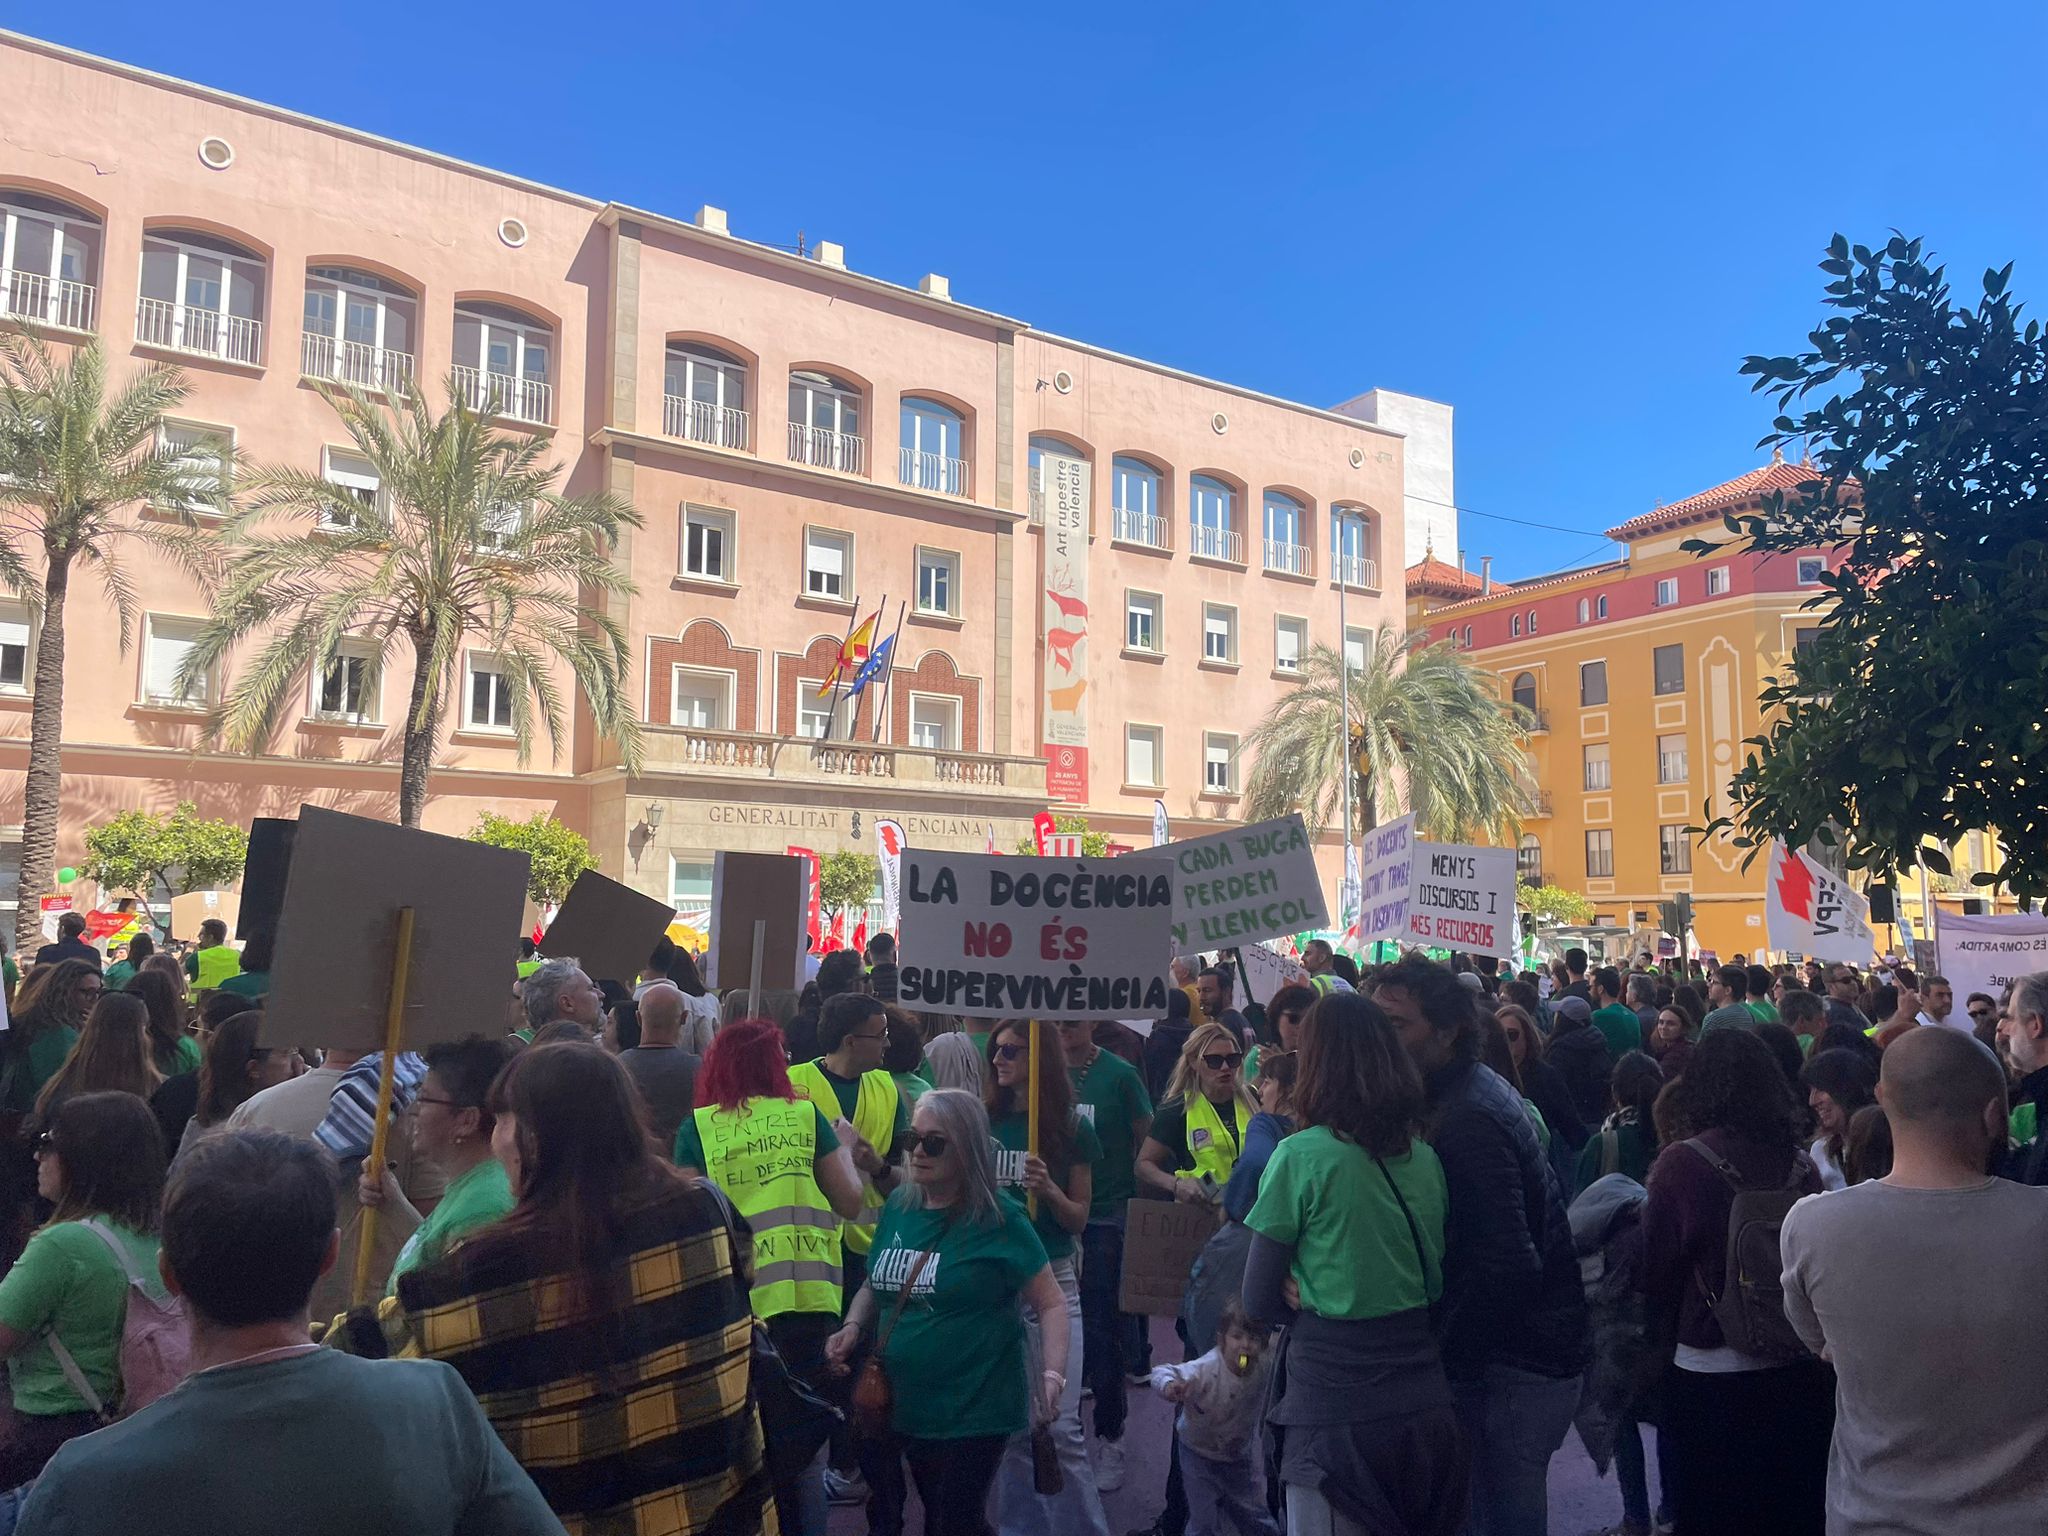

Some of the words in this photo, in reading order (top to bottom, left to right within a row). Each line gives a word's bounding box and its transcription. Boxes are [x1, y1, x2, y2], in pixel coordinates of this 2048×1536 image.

[1057, 460, 1069, 527] rupestre
[1068, 463, 1080, 528] valencià
[1056, 532, 1067, 557] Art
[709, 806, 838, 828] GENERALITAT
[874, 815, 982, 836] ENCIANA
[1179, 842, 1233, 874] CADA
[1432, 853, 1476, 879] MENYS
[909, 863, 958, 905] LA
[990, 863, 1171, 908] DOCÈNCIA
[1183, 868, 1279, 909] PERDEM
[1419, 884, 1479, 912] DISCURSOS
[1487, 892, 1497, 914] I
[963, 920, 1012, 958] NO
[1040, 915, 1088, 960] ÉS
[1171, 922, 1188, 946] N
[1200, 898, 1319, 941] LLENÇOL
[1436, 918, 1494, 948] RECURSOS
[900, 963, 1167, 1011] SUPERVIVÈNCIA
[715, 1110, 798, 1143] ENTRE
[711, 1145, 738, 1166] EL
[727, 1169, 752, 1186] EL
[756, 1156, 814, 1178] DESASTRE
[910, 1286, 936, 1294] OCA
